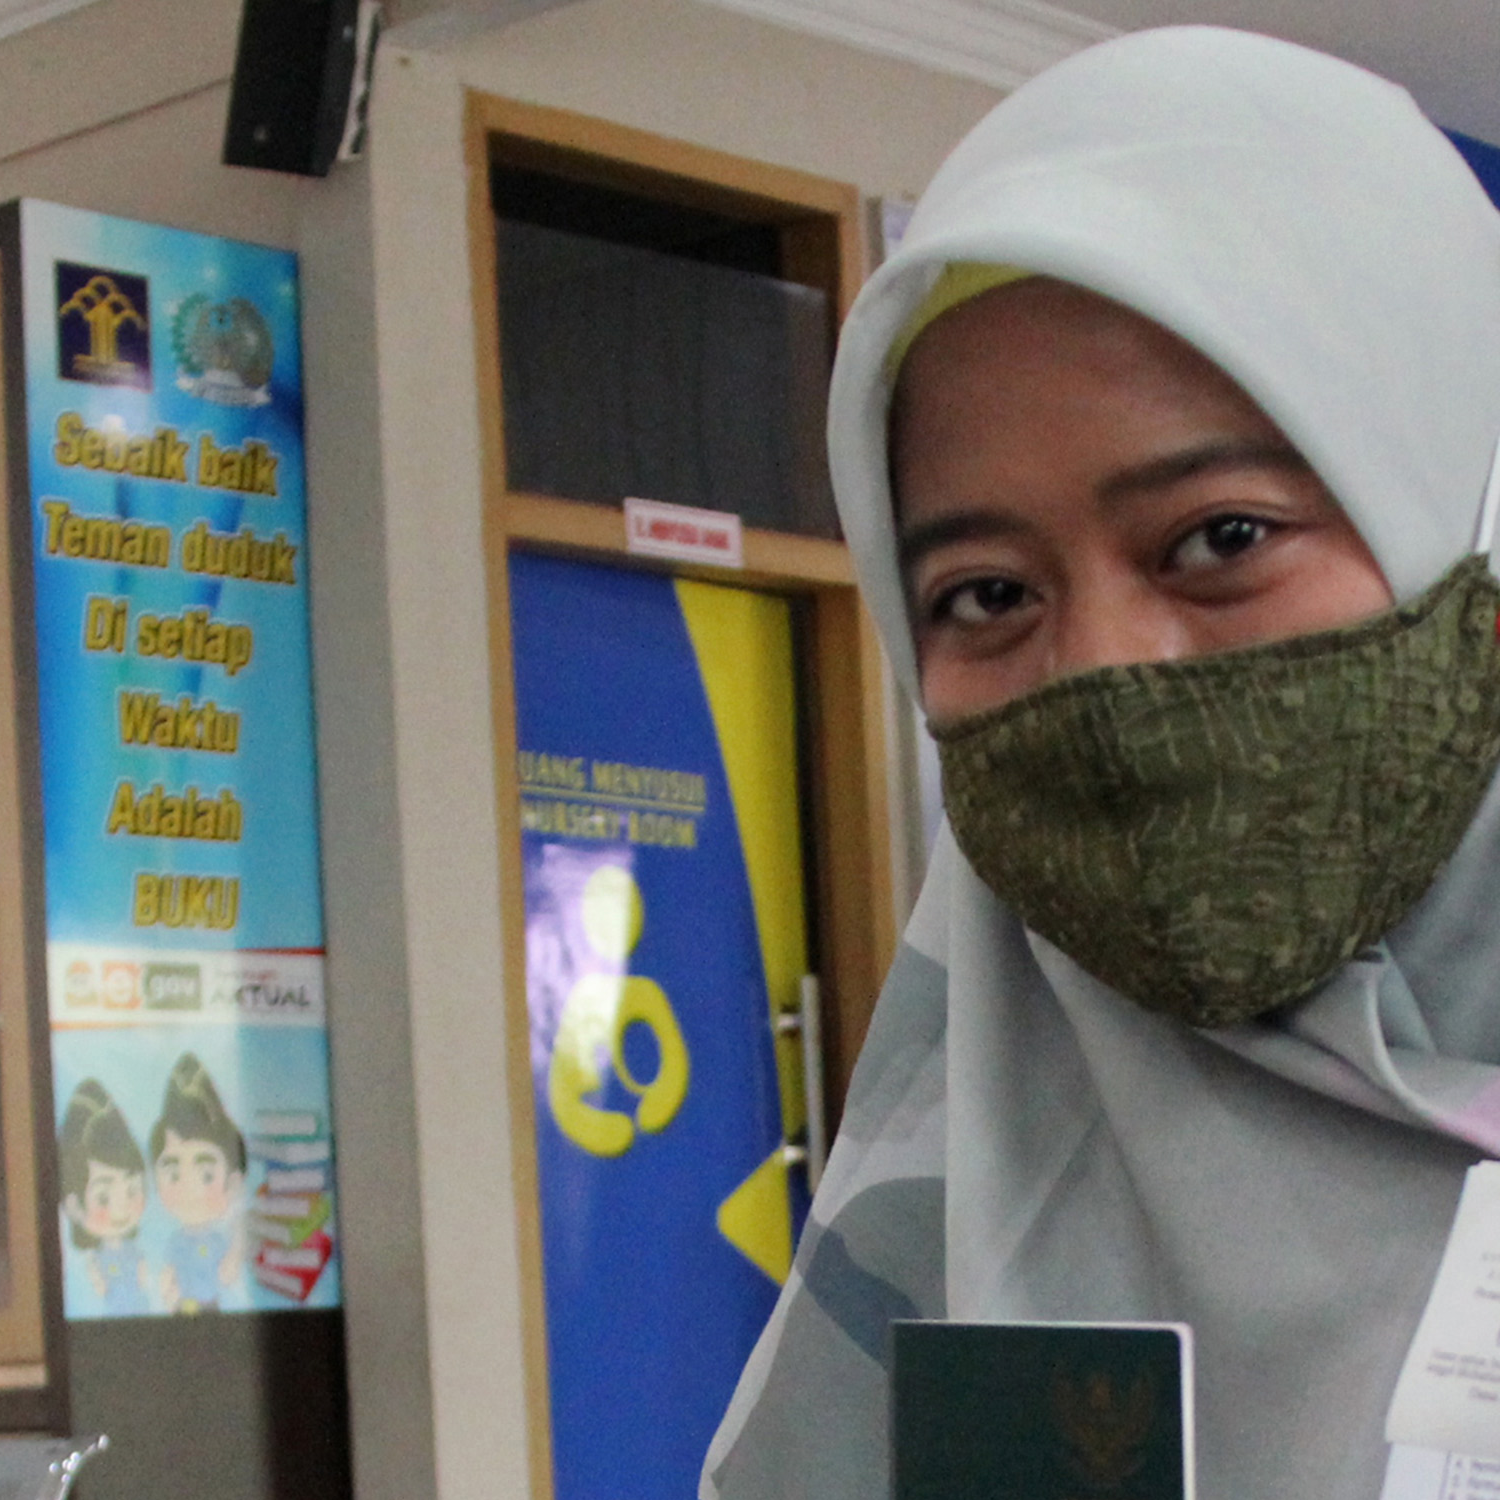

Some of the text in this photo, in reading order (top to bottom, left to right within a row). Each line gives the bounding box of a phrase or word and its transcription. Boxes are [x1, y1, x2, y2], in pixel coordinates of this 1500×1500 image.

[53, 410, 280, 498] Sebaik baik
[41, 500, 299, 586] Teman duduk
[83, 594, 253, 675] Di setiap
[117, 688, 239, 753] Waktu
[518, 750, 586, 790] UANG
[106, 778, 244, 844] Adalah
[133, 871, 240, 932] BUKU
